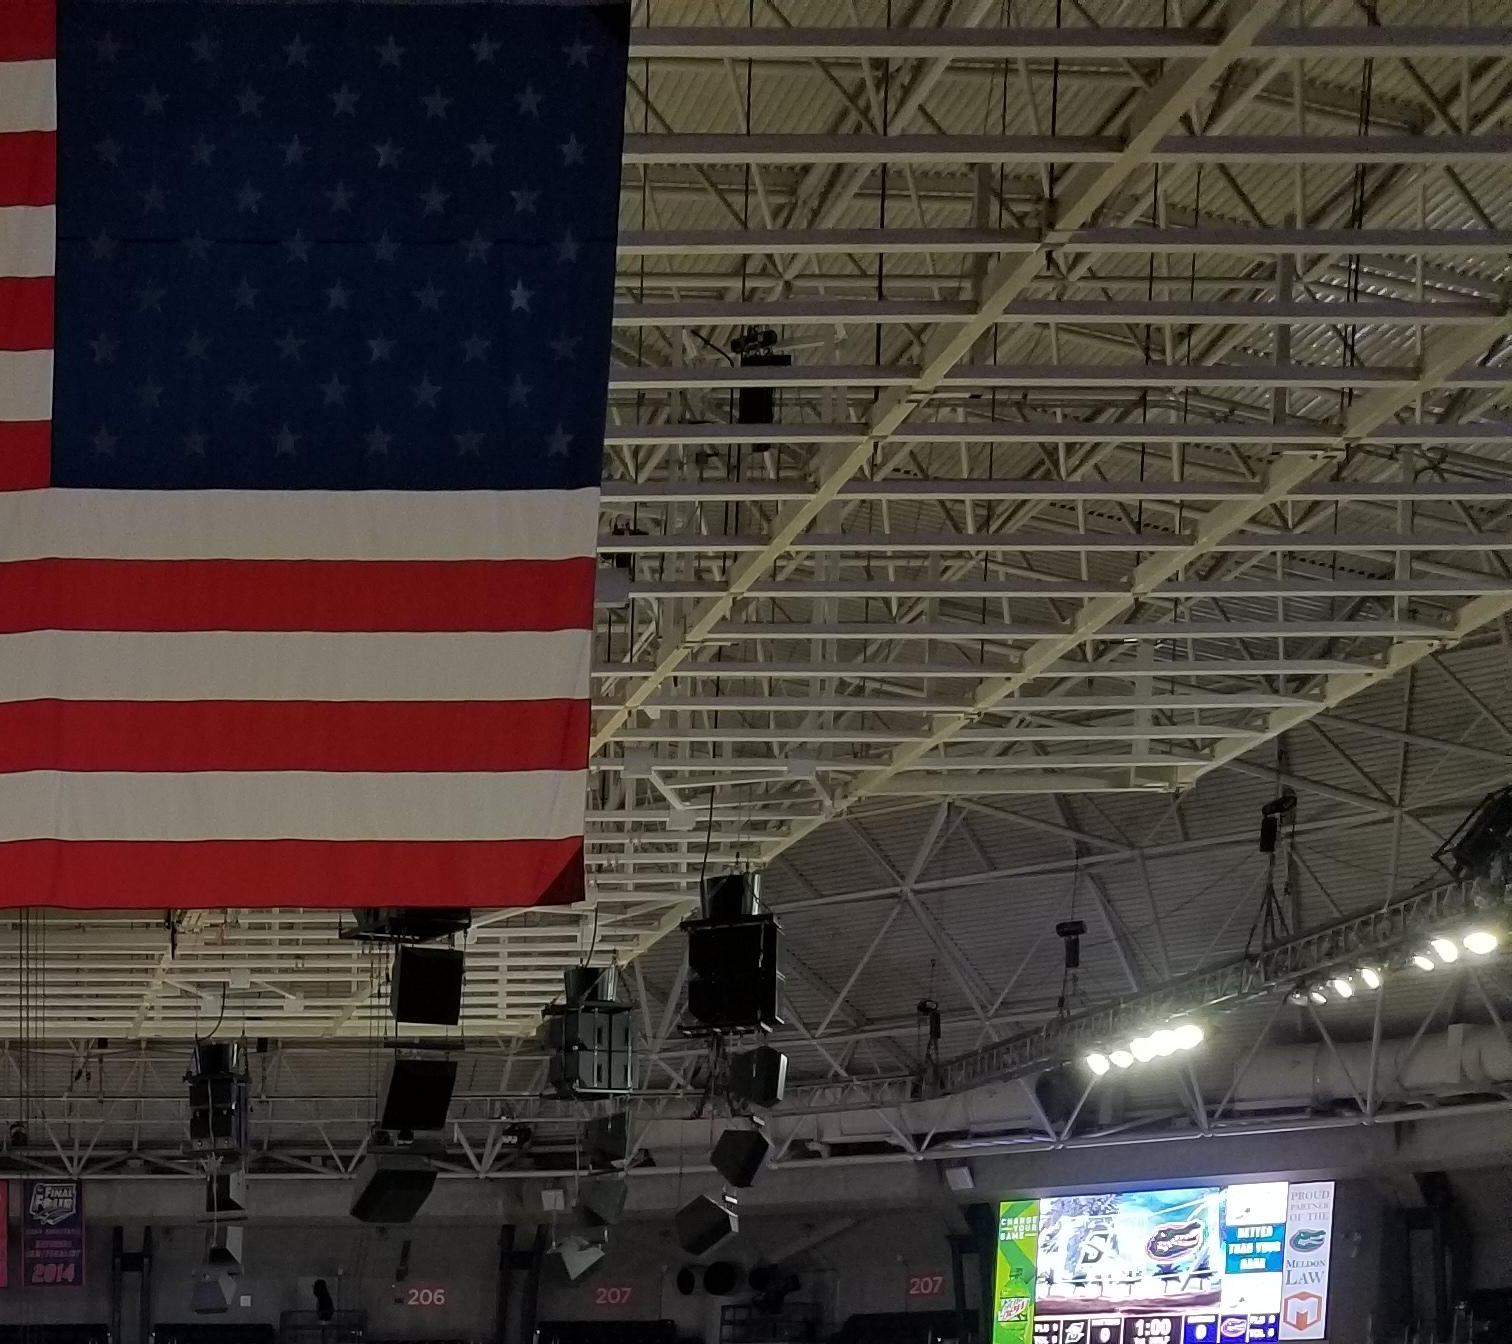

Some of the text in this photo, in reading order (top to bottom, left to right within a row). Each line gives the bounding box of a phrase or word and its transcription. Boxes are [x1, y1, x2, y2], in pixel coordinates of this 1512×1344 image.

[1291, 1190, 1330, 1201] PROUD
[31, 1263, 76, 1283] 2014
[1285, 1269, 1325, 1286] LAW
[908, 1275, 944, 1295] 207
[406, 1288, 446, 1306] 206
[595, 1287, 633, 1305] 207
[1134, 1318, 1172, 1337] 1:00
